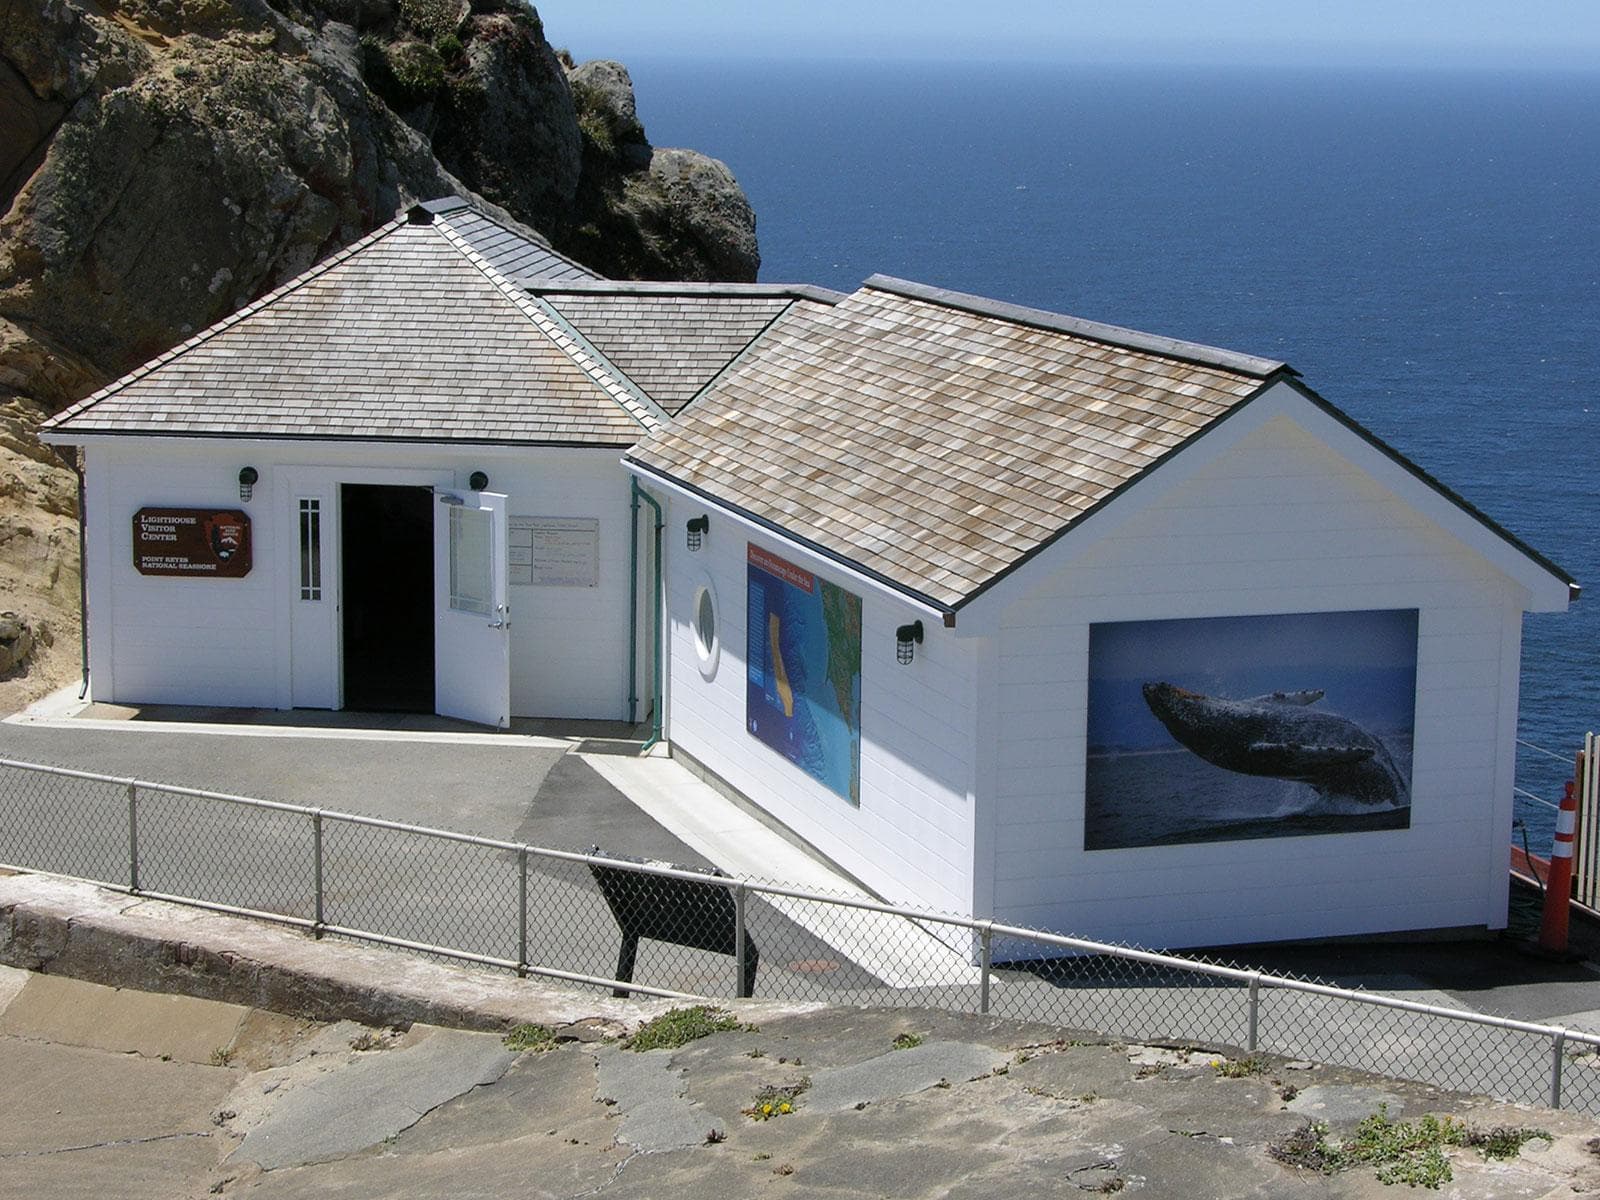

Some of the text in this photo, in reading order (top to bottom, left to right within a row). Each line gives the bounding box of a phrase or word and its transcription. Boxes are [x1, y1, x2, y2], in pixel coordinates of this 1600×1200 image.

[141, 515, 197, 524] LIGHTHOUSE
[141, 524, 176, 532] VISITOR
[141, 532, 177, 541] CENTER
